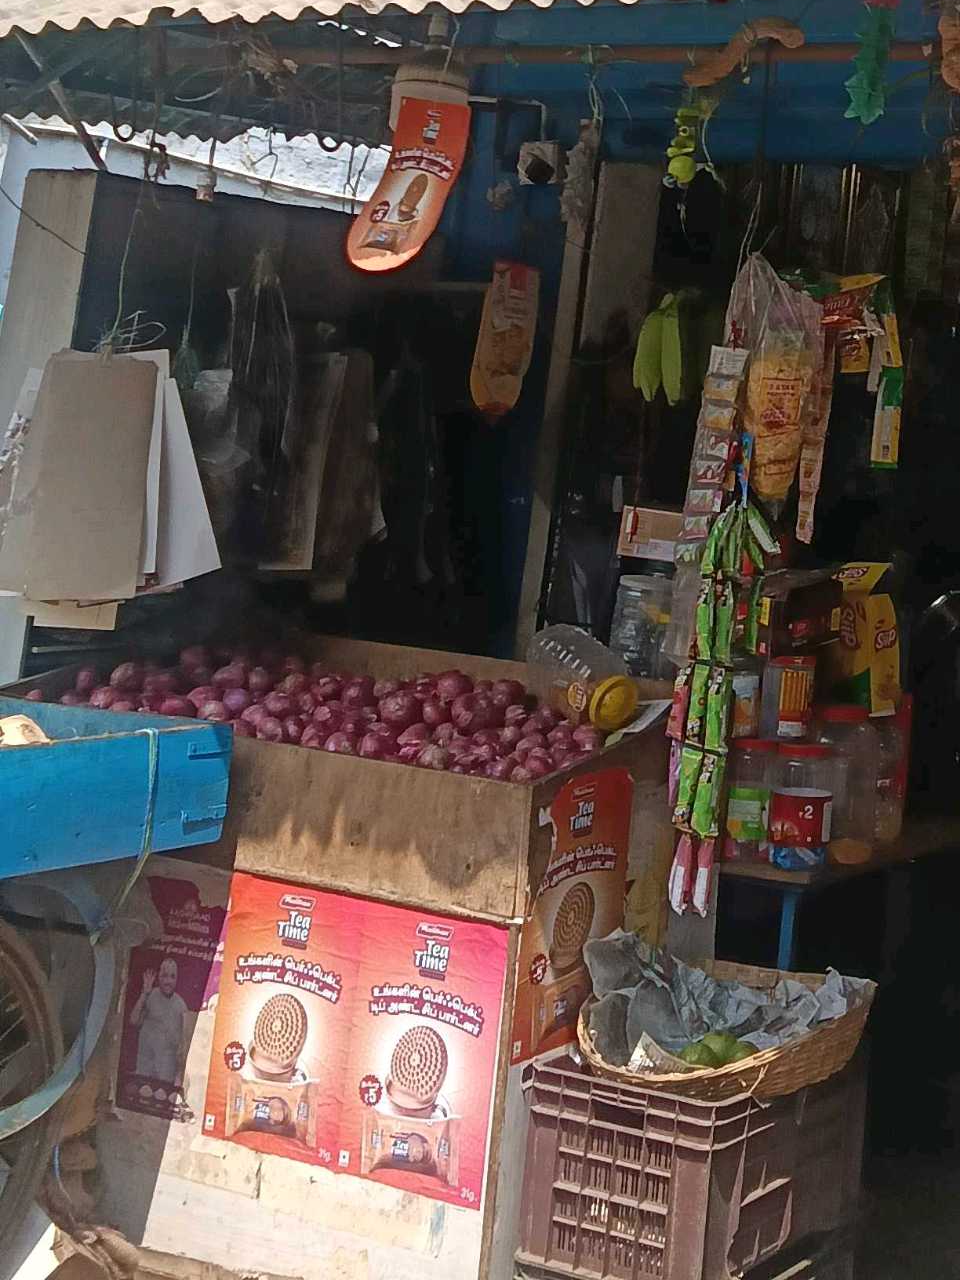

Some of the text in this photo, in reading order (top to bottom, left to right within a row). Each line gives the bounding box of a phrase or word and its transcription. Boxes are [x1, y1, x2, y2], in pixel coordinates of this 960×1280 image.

[289, 910, 312, 930] Tea
[277, 920, 309, 942] Time
[426, 939, 449, 959] Tea
[414, 950, 447, 972] Time
